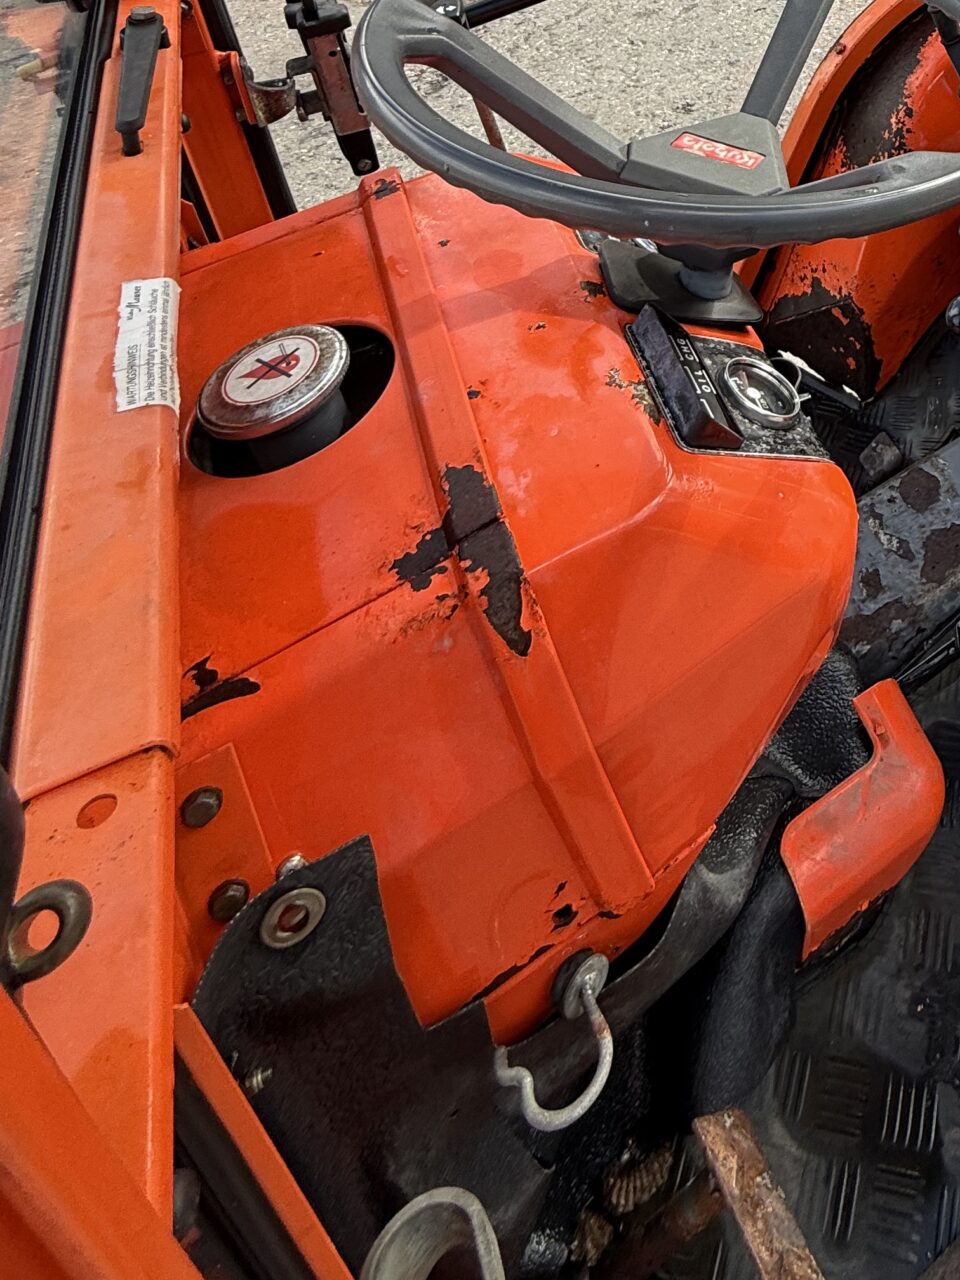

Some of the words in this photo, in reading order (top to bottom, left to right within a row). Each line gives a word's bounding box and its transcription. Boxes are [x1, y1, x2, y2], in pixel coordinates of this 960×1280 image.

[682, 136, 756, 167] Kubota
[677, 338, 695, 361] CHG
[126, 343, 138, 406] WARTUNGSHINWEIS
[694, 369, 712, 393] OIL
